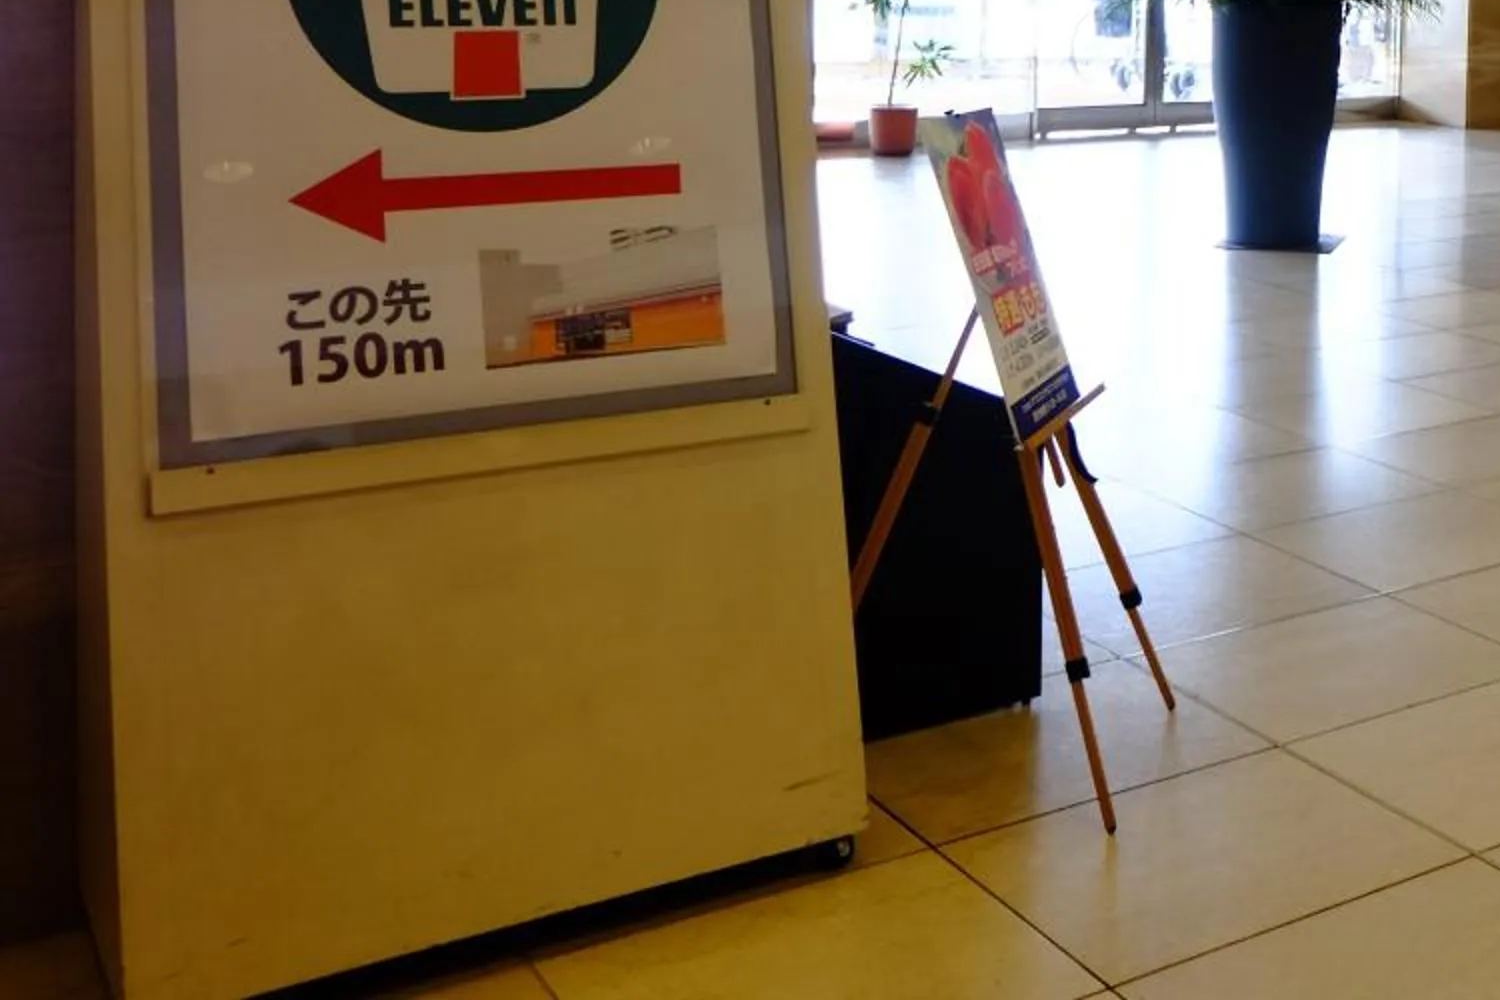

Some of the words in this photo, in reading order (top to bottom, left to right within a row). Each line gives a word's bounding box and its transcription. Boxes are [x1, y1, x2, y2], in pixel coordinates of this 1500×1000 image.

[286, 278, 432, 330] この先
[278, 331, 446, 387] 150m
